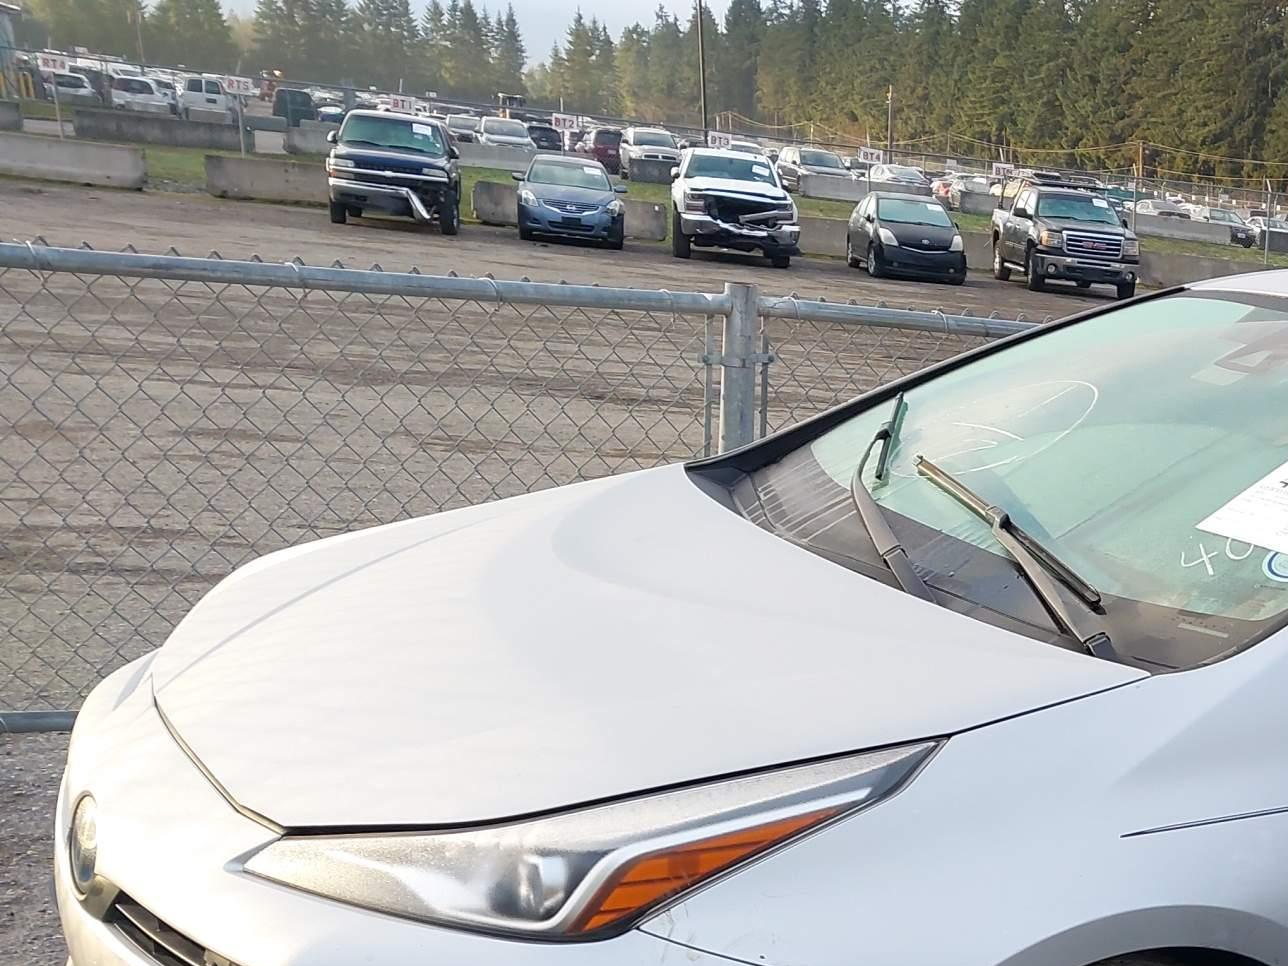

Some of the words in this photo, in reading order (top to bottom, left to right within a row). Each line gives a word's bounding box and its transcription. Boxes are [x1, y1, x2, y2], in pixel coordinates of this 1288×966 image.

[227, 79, 249, 90] RT5
[393, 98, 412, 110] BT1
[554, 117, 575, 129] BT2
[710, 135, 730, 146] BT3
[863, 151, 881, 162] BT4
